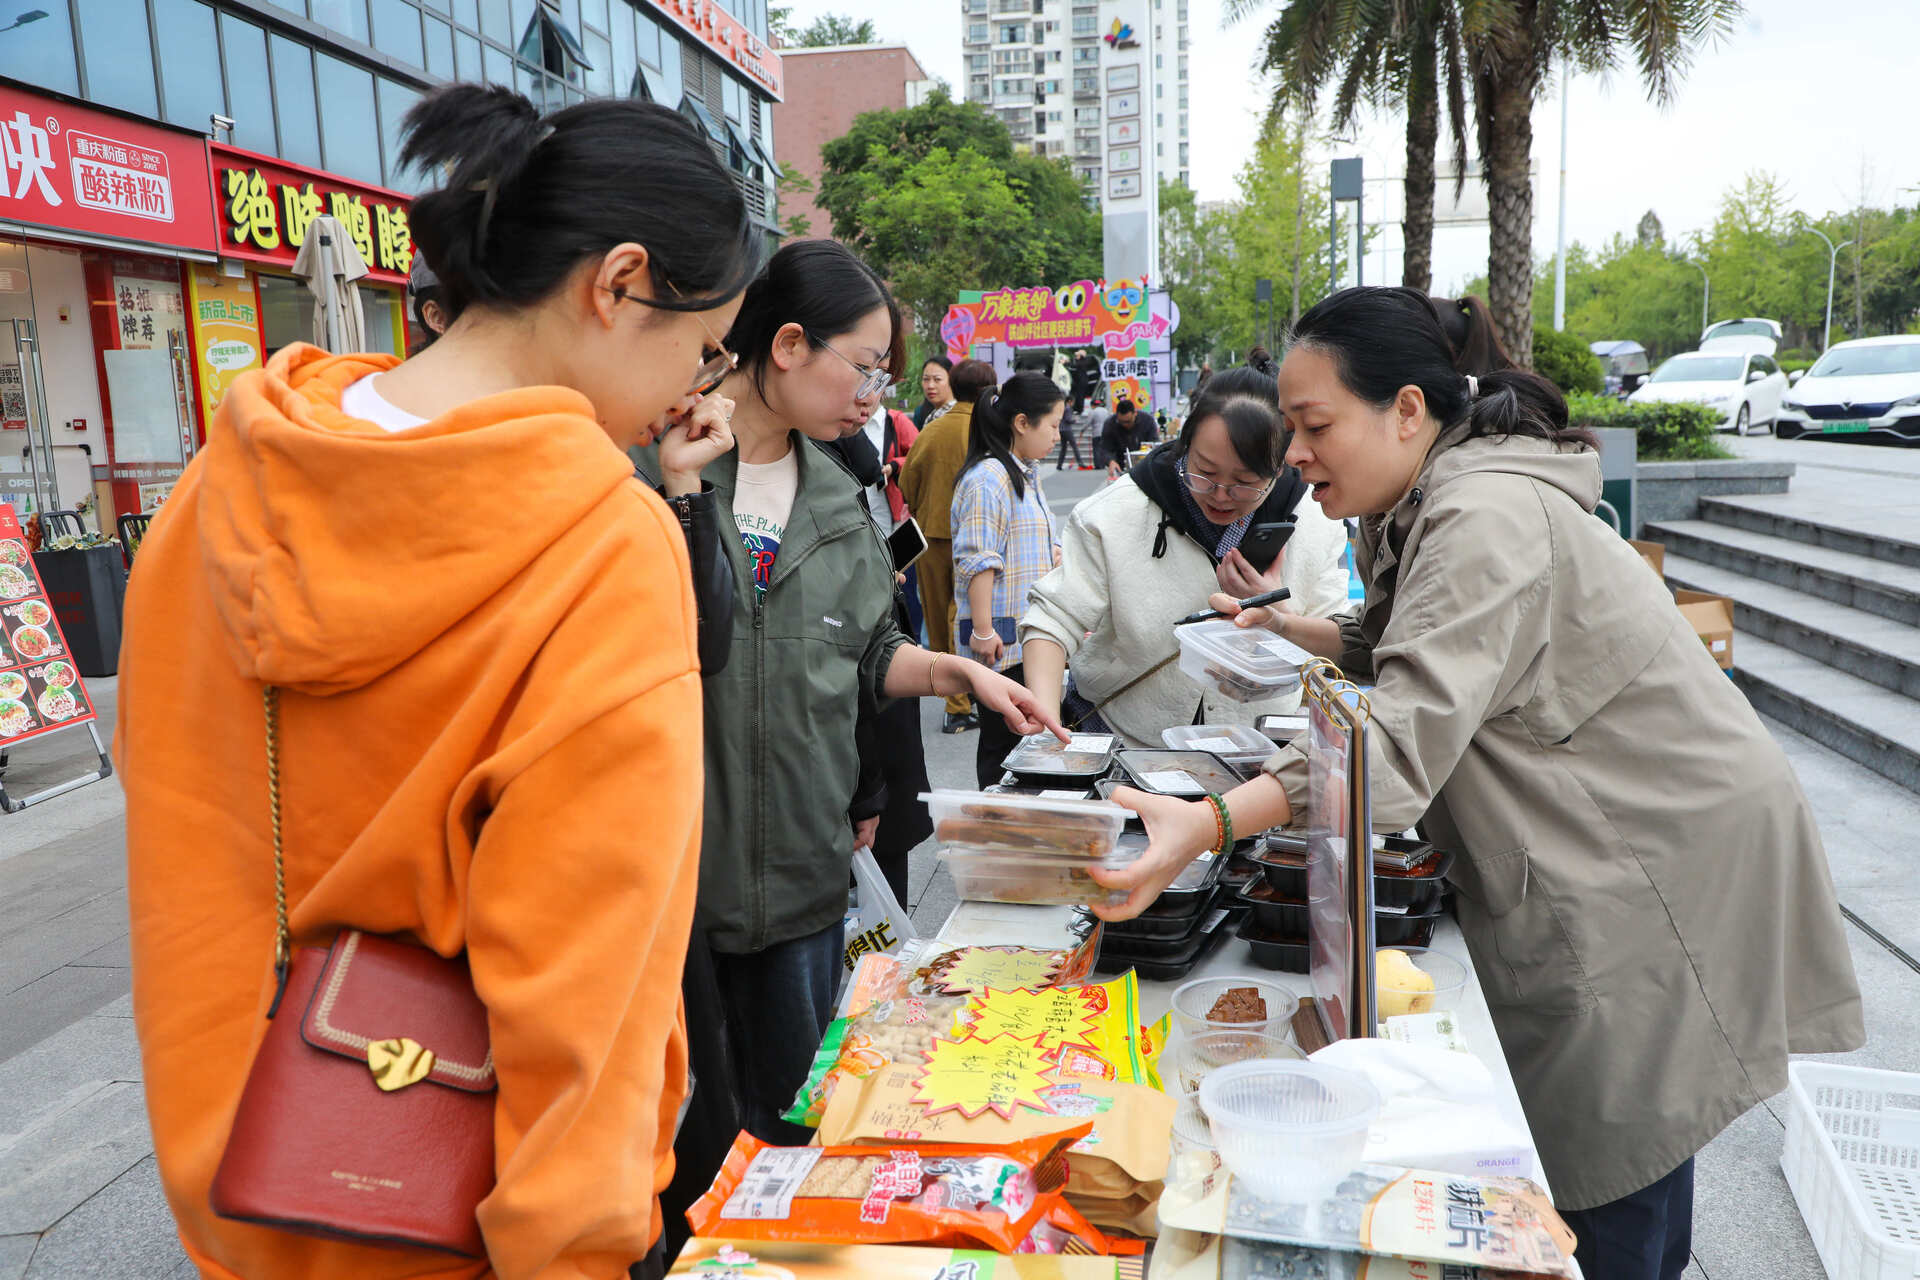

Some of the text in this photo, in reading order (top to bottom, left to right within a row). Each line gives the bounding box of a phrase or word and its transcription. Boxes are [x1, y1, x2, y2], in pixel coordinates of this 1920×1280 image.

[76, 137, 128, 165] 重庆粉面
[80, 163, 166, 215] 酸辣粉
[225, 167, 413, 274] 绝味鸭脖
[199, 300, 255, 323] 新品上市
[979, 290, 1049, 321] 万象森邻
[1103, 359, 1159, 378] 便民消费节
[734, 513, 754, 530] THE
